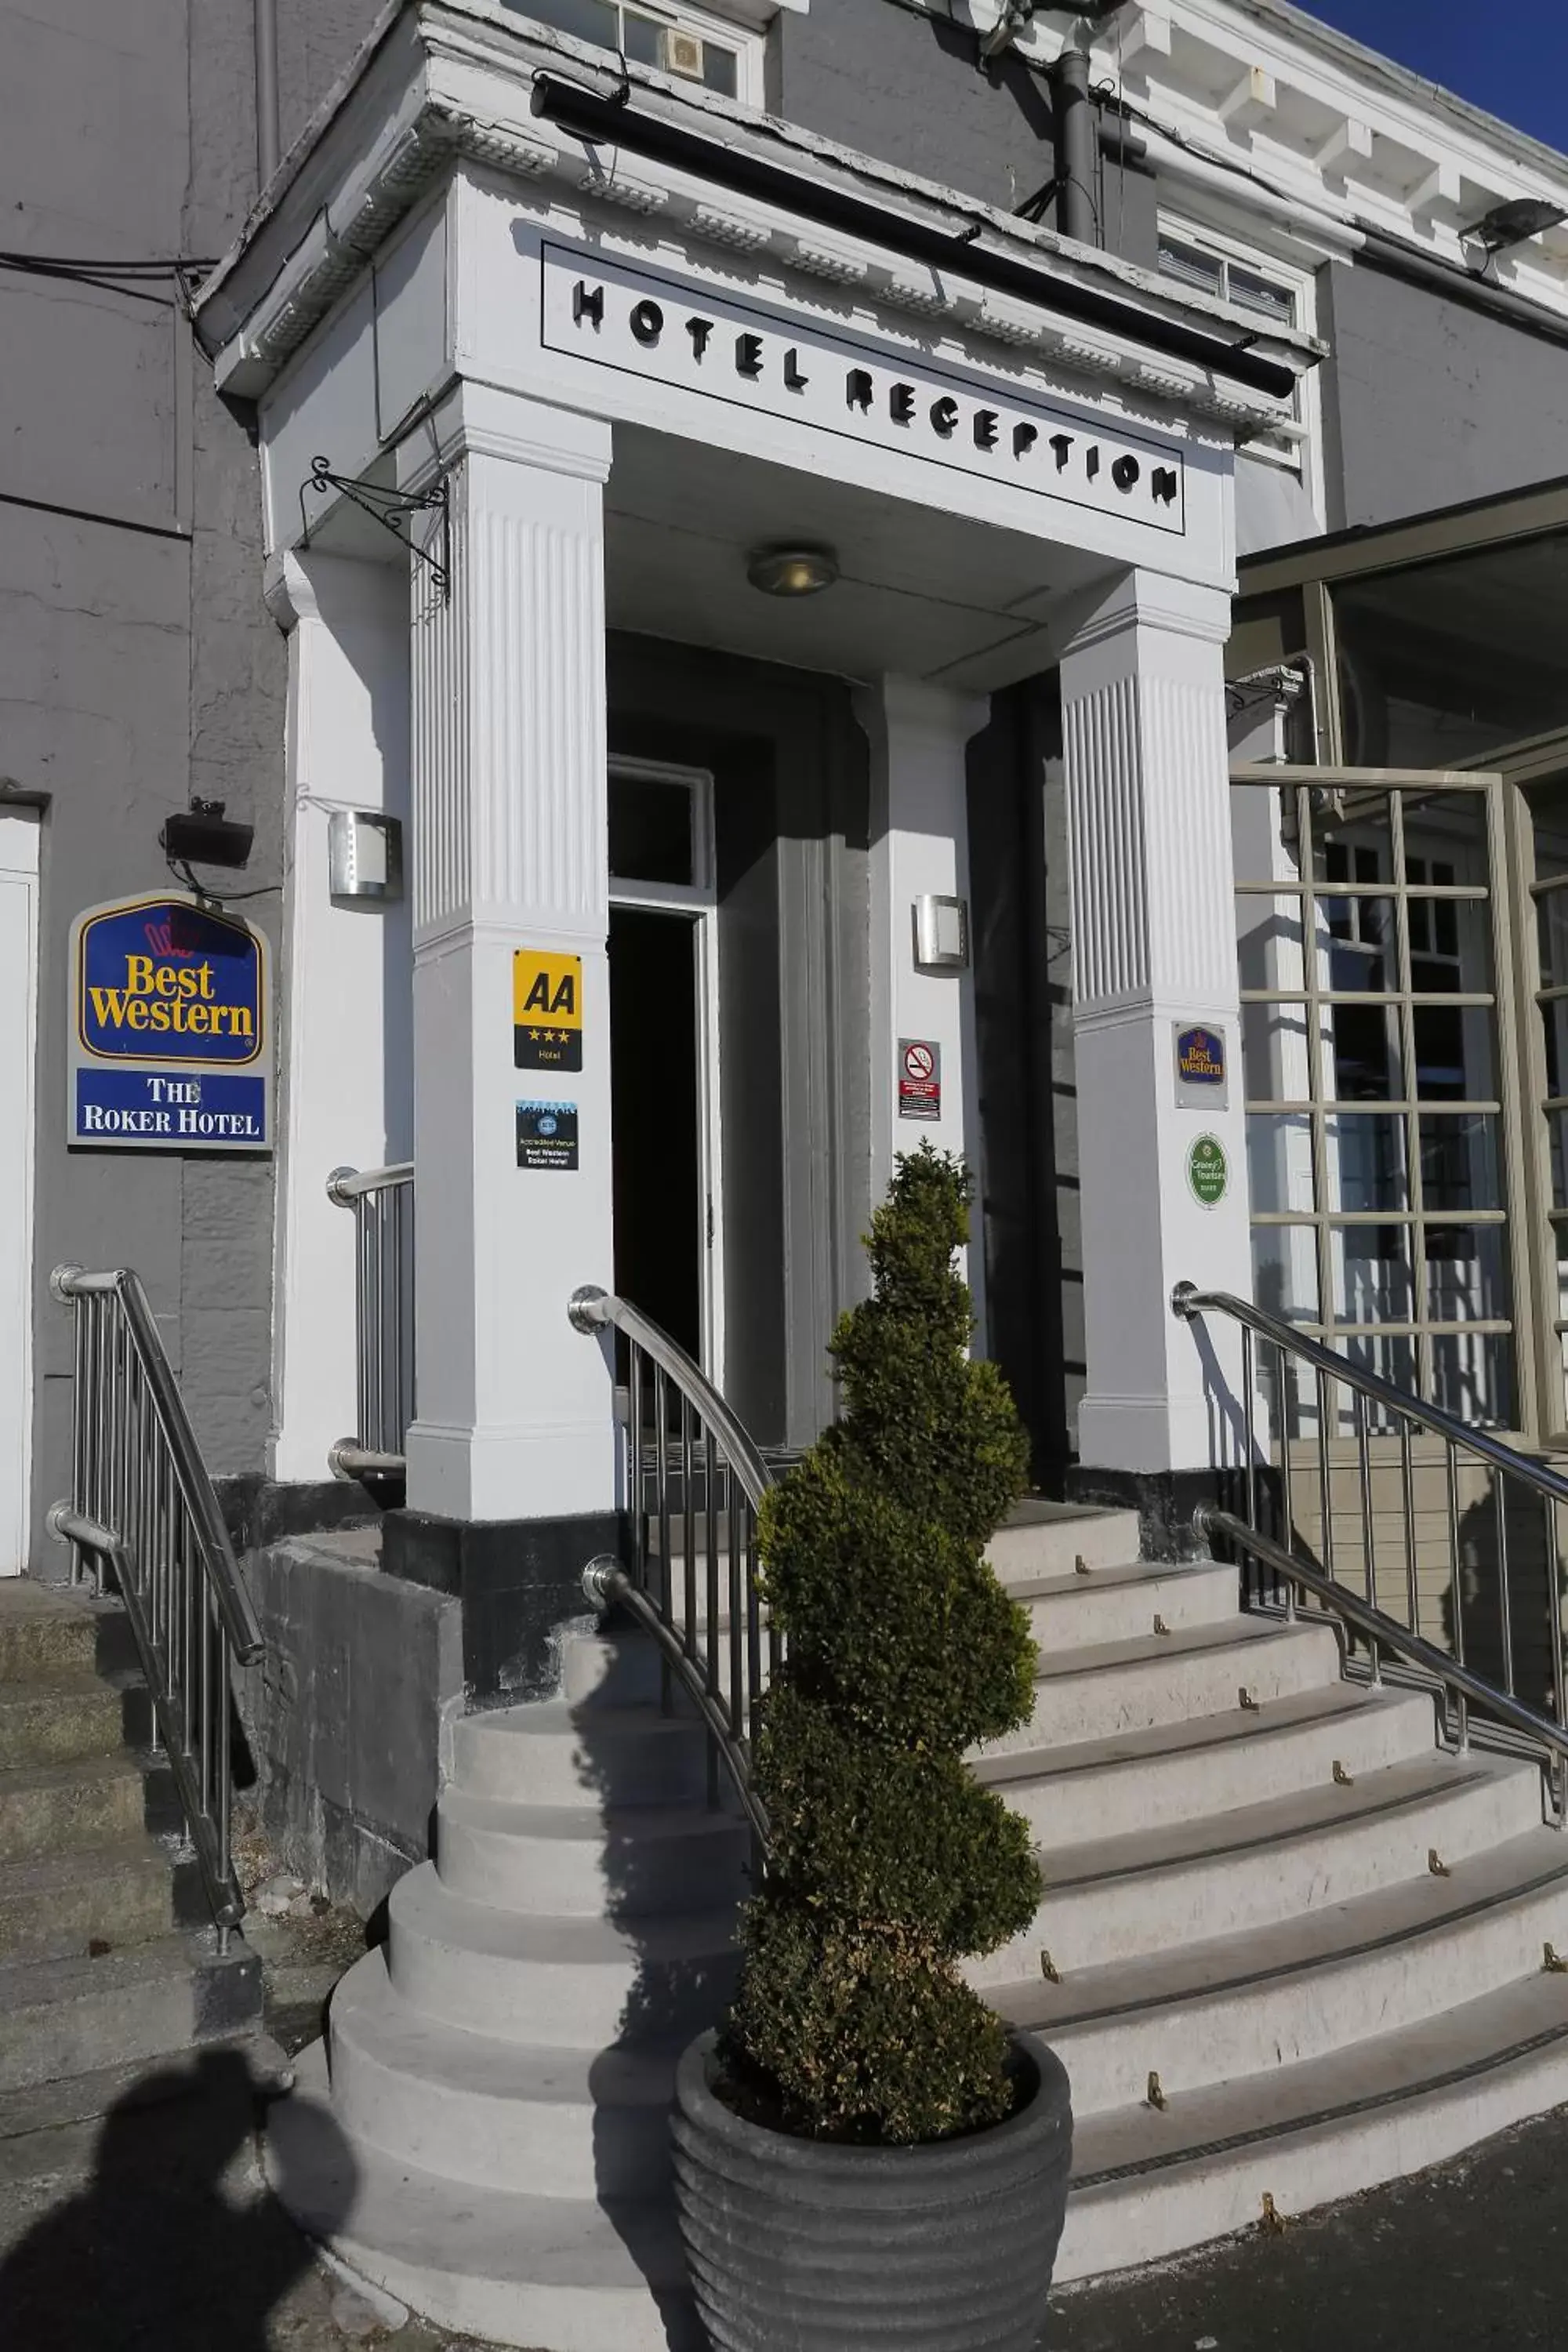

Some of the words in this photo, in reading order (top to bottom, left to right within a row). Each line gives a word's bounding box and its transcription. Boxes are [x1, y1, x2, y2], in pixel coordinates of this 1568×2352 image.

[573, 280, 809, 391] HOTEL
[846, 368, 1178, 504] RECEPTION
[125, 954, 216, 1000] Best
[523, 972, 575, 1014] AA
[88, 986, 254, 1036] Western
[539, 1050, 561, 1059] Hotel
[1181, 1058, 1221, 1075] Western
[1188, 1047, 1211, 1062] Best
[147, 1078, 201, 1103] THE
[83, 1105, 171, 1132] ROKER
[178, 1109, 260, 1136] HOTEL
